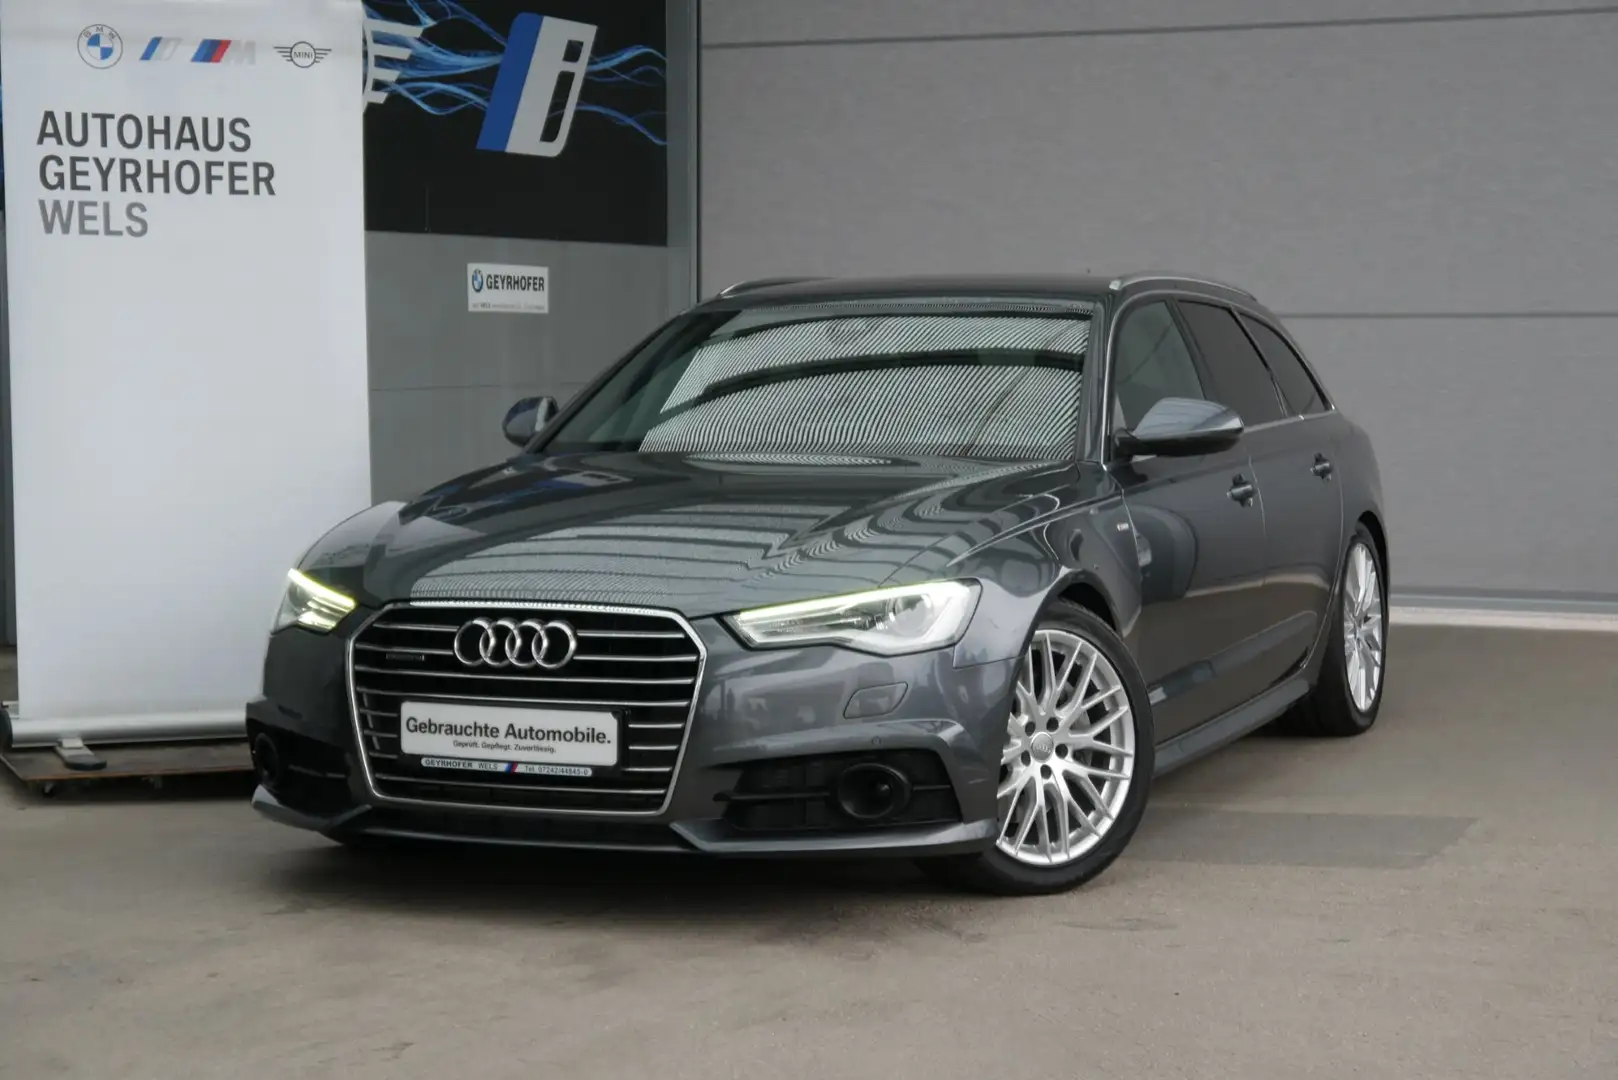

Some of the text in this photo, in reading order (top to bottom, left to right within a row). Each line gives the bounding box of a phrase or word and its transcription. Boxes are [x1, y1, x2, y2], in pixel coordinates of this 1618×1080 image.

[82, 26, 117, 40] BMW
[293, 51, 313, 59] MINI
[37, 110, 251, 152] AUTOHAUS
[39, 154, 276, 196] GEYRHOFER
[38, 199, 148, 237] WELS
[486, 274, 545, 292] GEYRHOFER
[406, 716, 611, 745] Gebrauchte Automobile.
[424, 758, 499, 770] GEYRHOFER WELS
